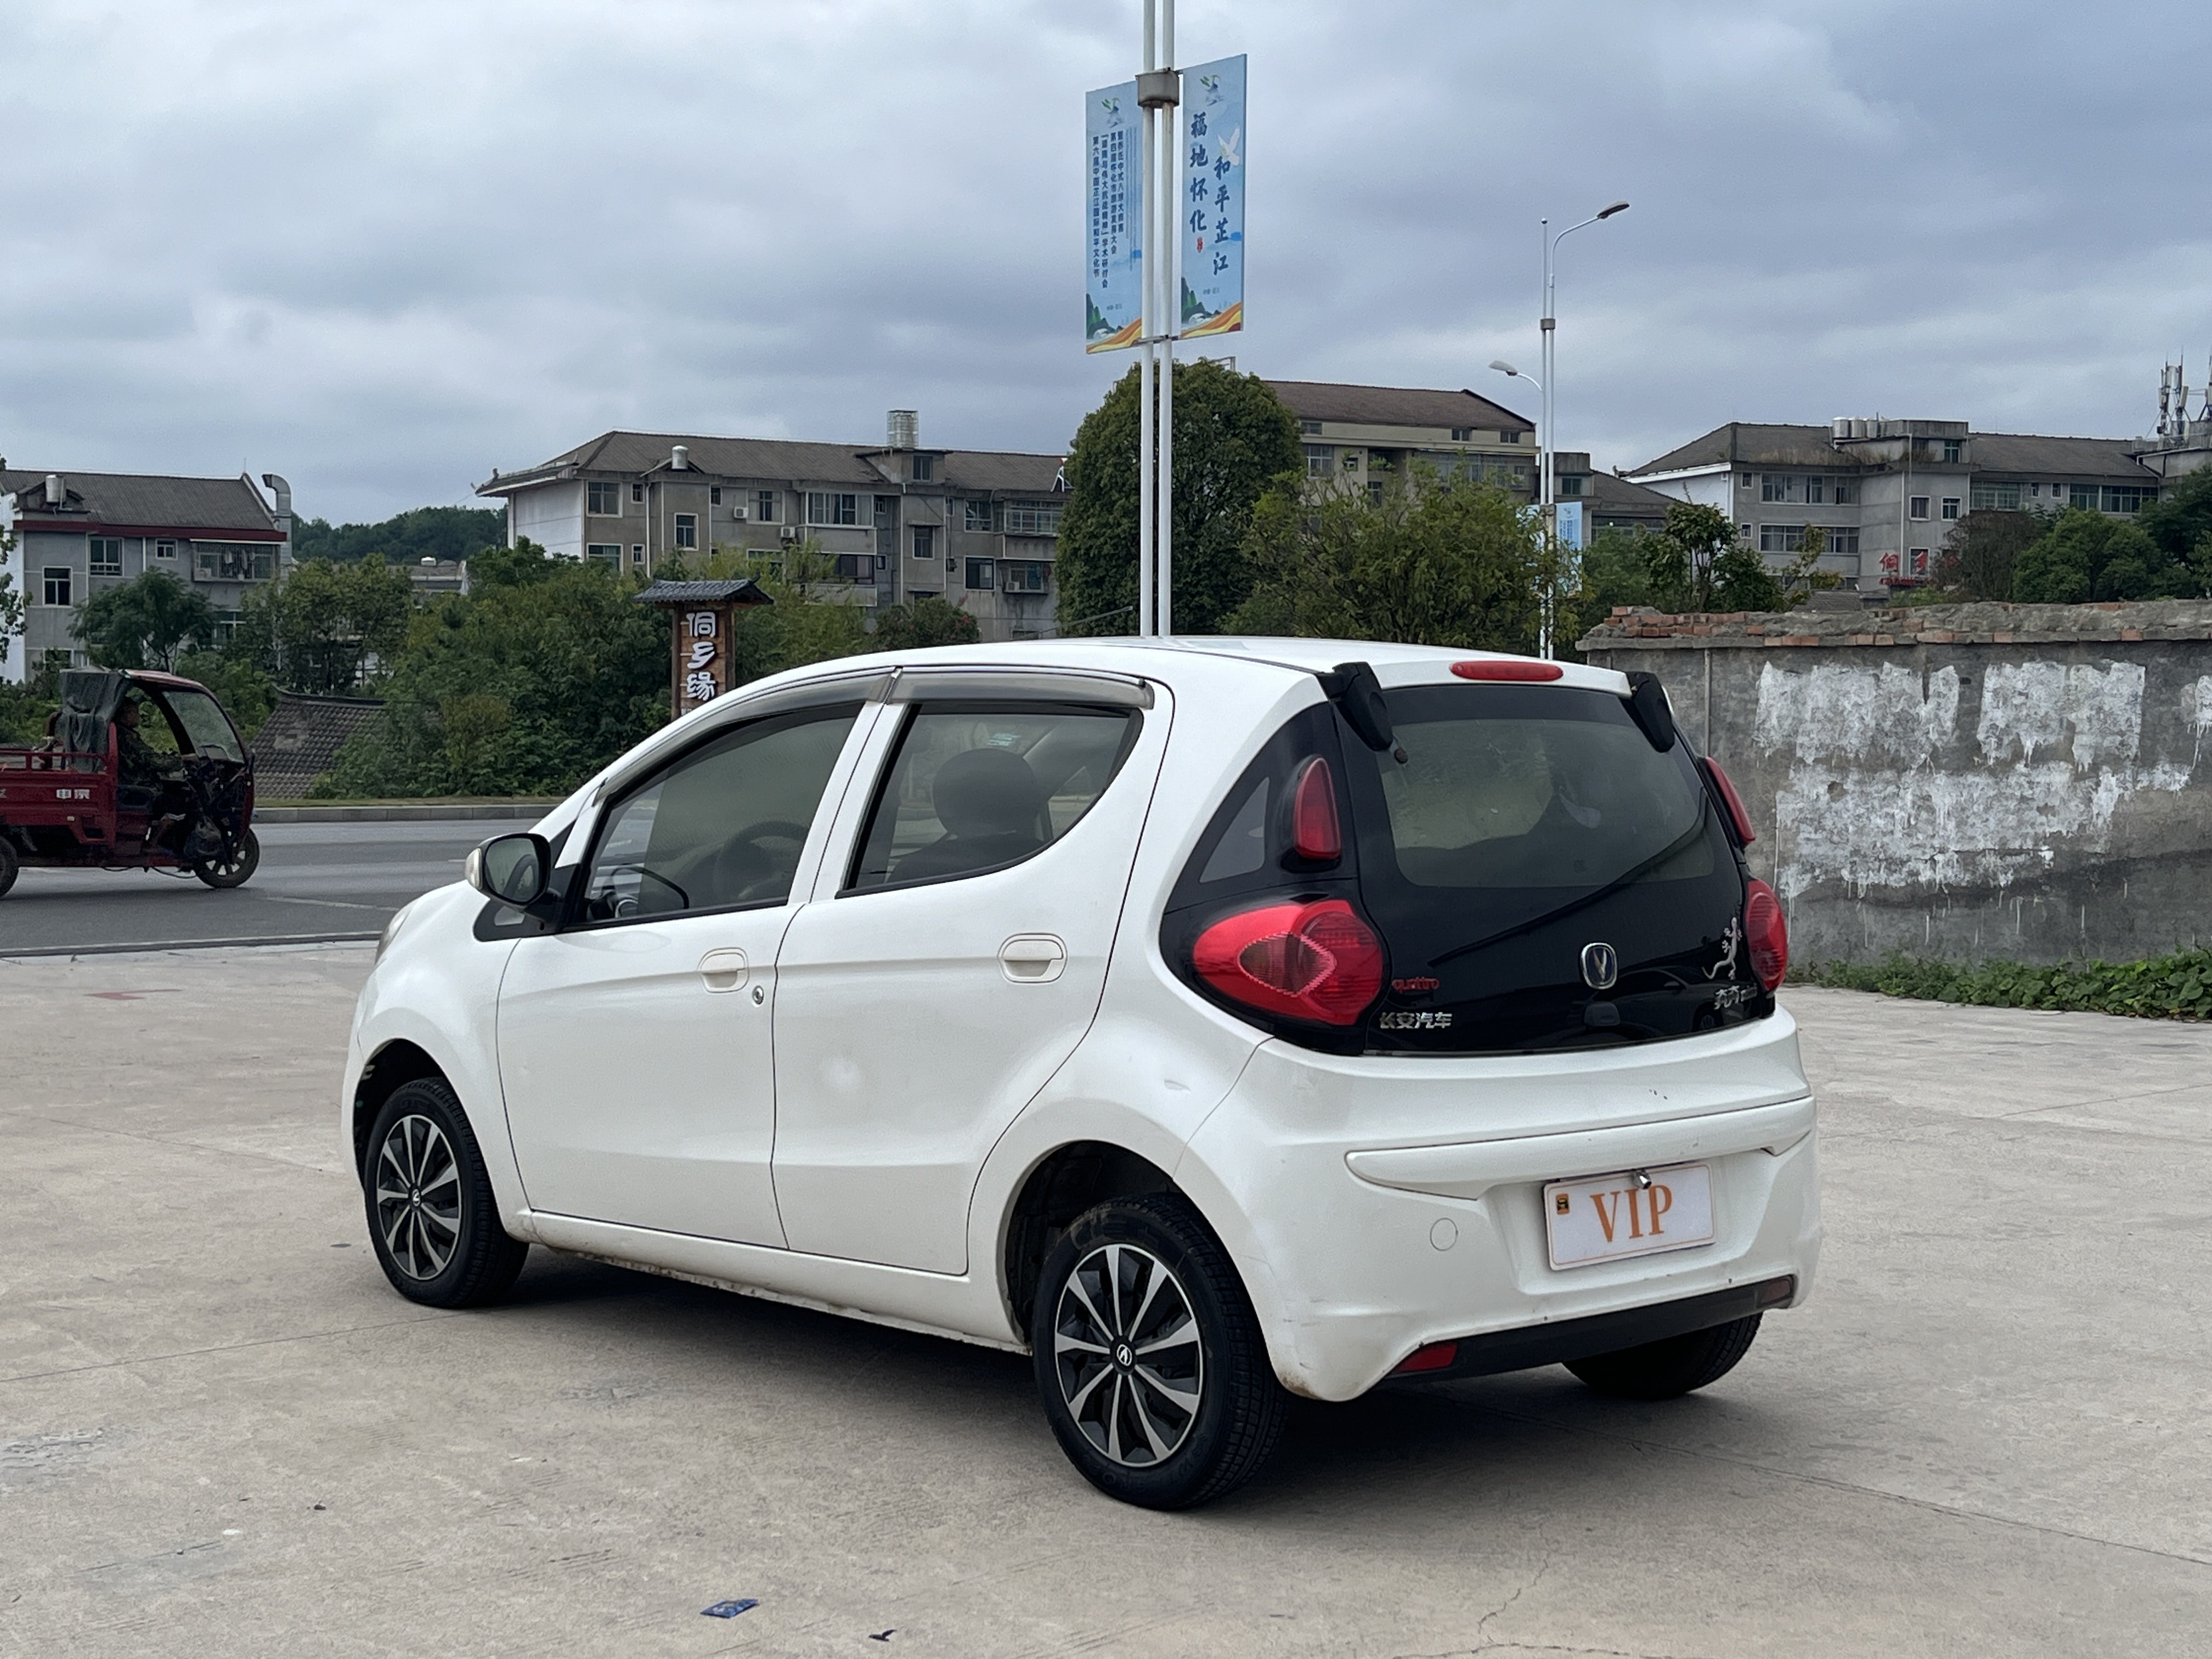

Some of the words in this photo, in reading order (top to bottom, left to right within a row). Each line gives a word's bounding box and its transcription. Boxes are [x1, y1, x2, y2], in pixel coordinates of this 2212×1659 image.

[1189, 111, 1209, 233] 福地怀化
[1214, 156, 1231, 275] 和平芷江
[1379, 1012, 1452, 1029] 长安汽车
[1589, 1184, 1673, 1243] VIP
